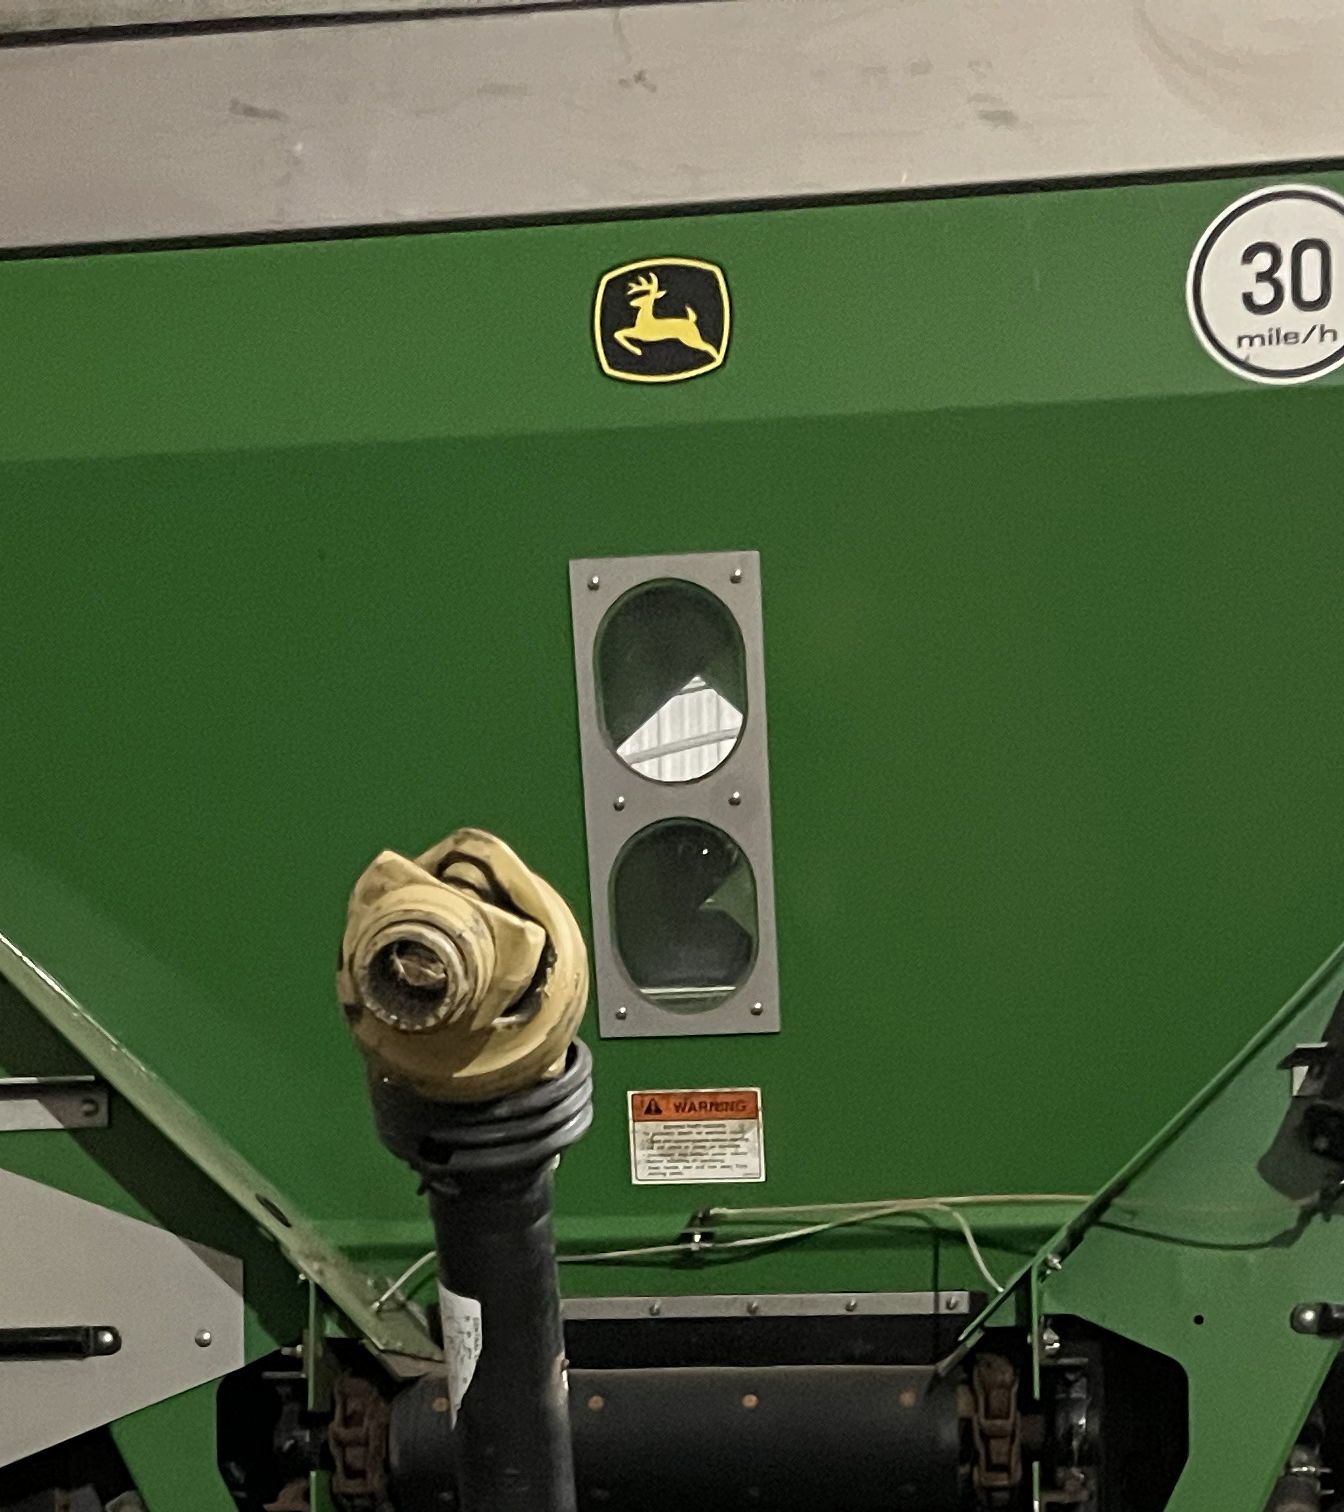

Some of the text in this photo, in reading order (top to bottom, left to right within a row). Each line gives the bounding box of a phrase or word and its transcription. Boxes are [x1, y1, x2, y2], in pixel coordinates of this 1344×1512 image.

[1240, 238, 1332, 316] 30
[1236, 323, 1338, 349] mile/h
[672, 1099, 747, 1114] WARNING
